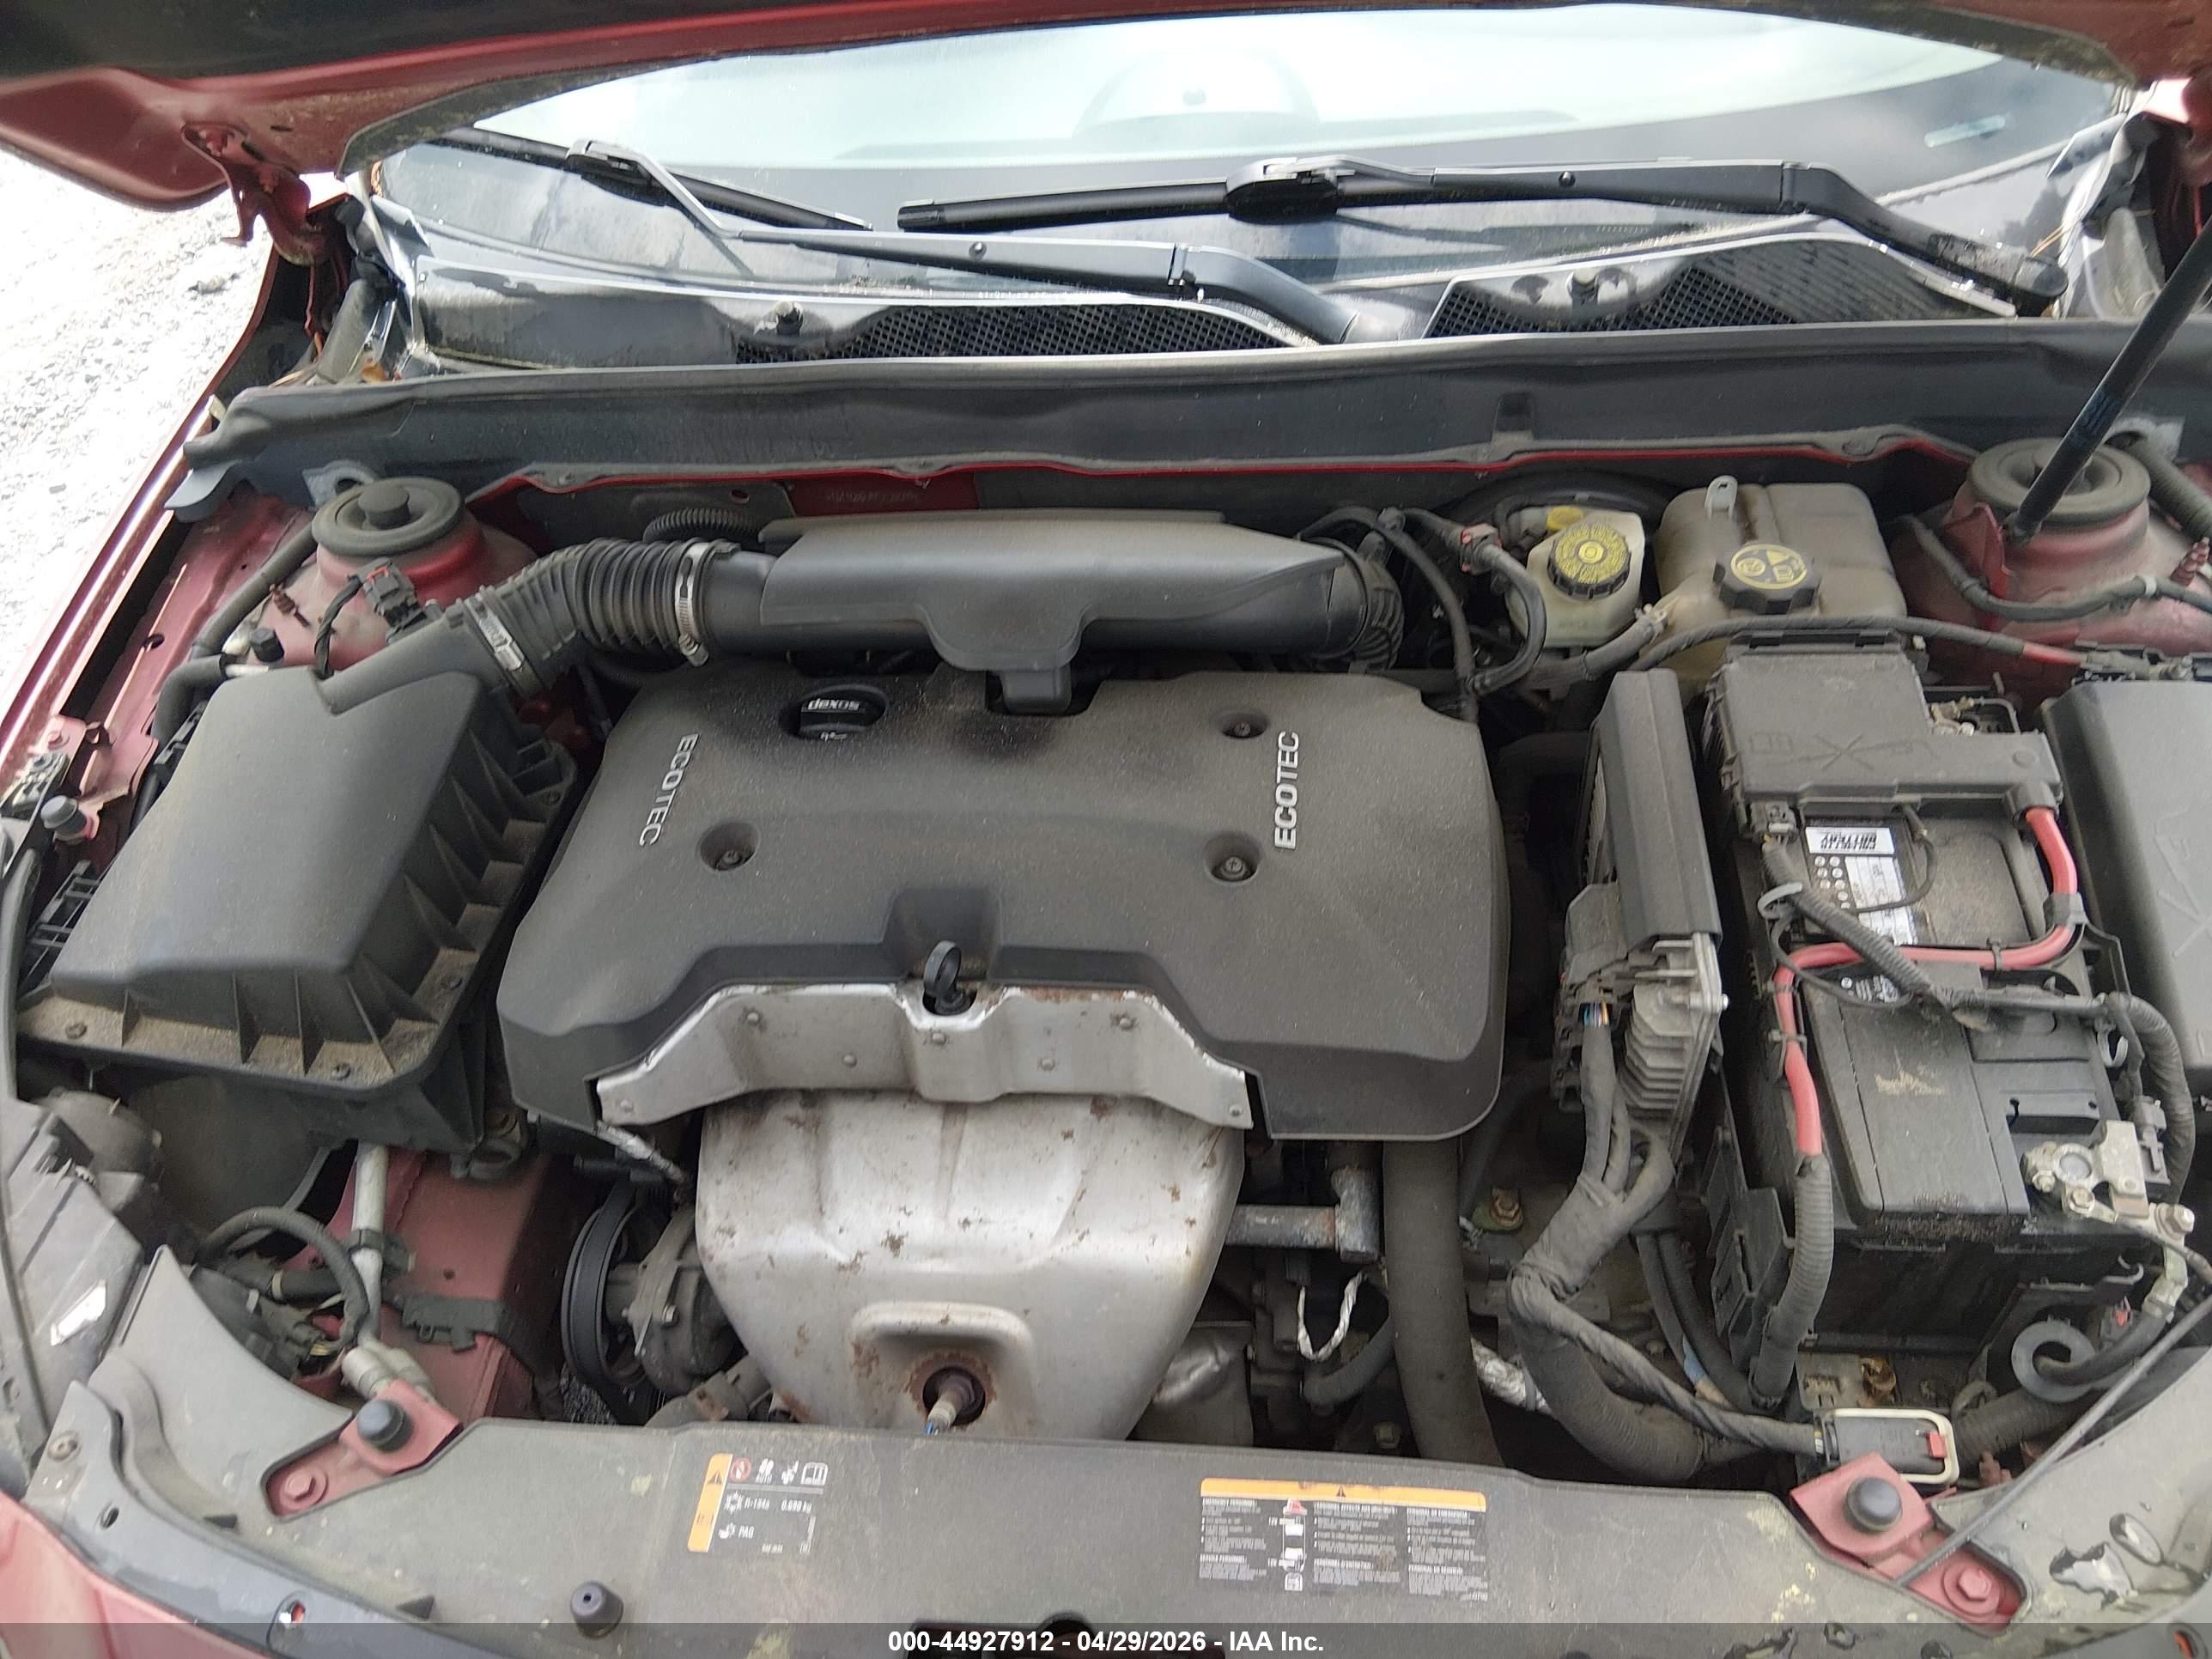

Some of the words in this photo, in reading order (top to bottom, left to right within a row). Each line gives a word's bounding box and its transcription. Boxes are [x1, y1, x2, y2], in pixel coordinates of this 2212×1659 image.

[807, 698, 860, 711] dexos
[639, 733, 700, 847] ECOTEC
[1274, 731, 1299, 849] ECOTEC
